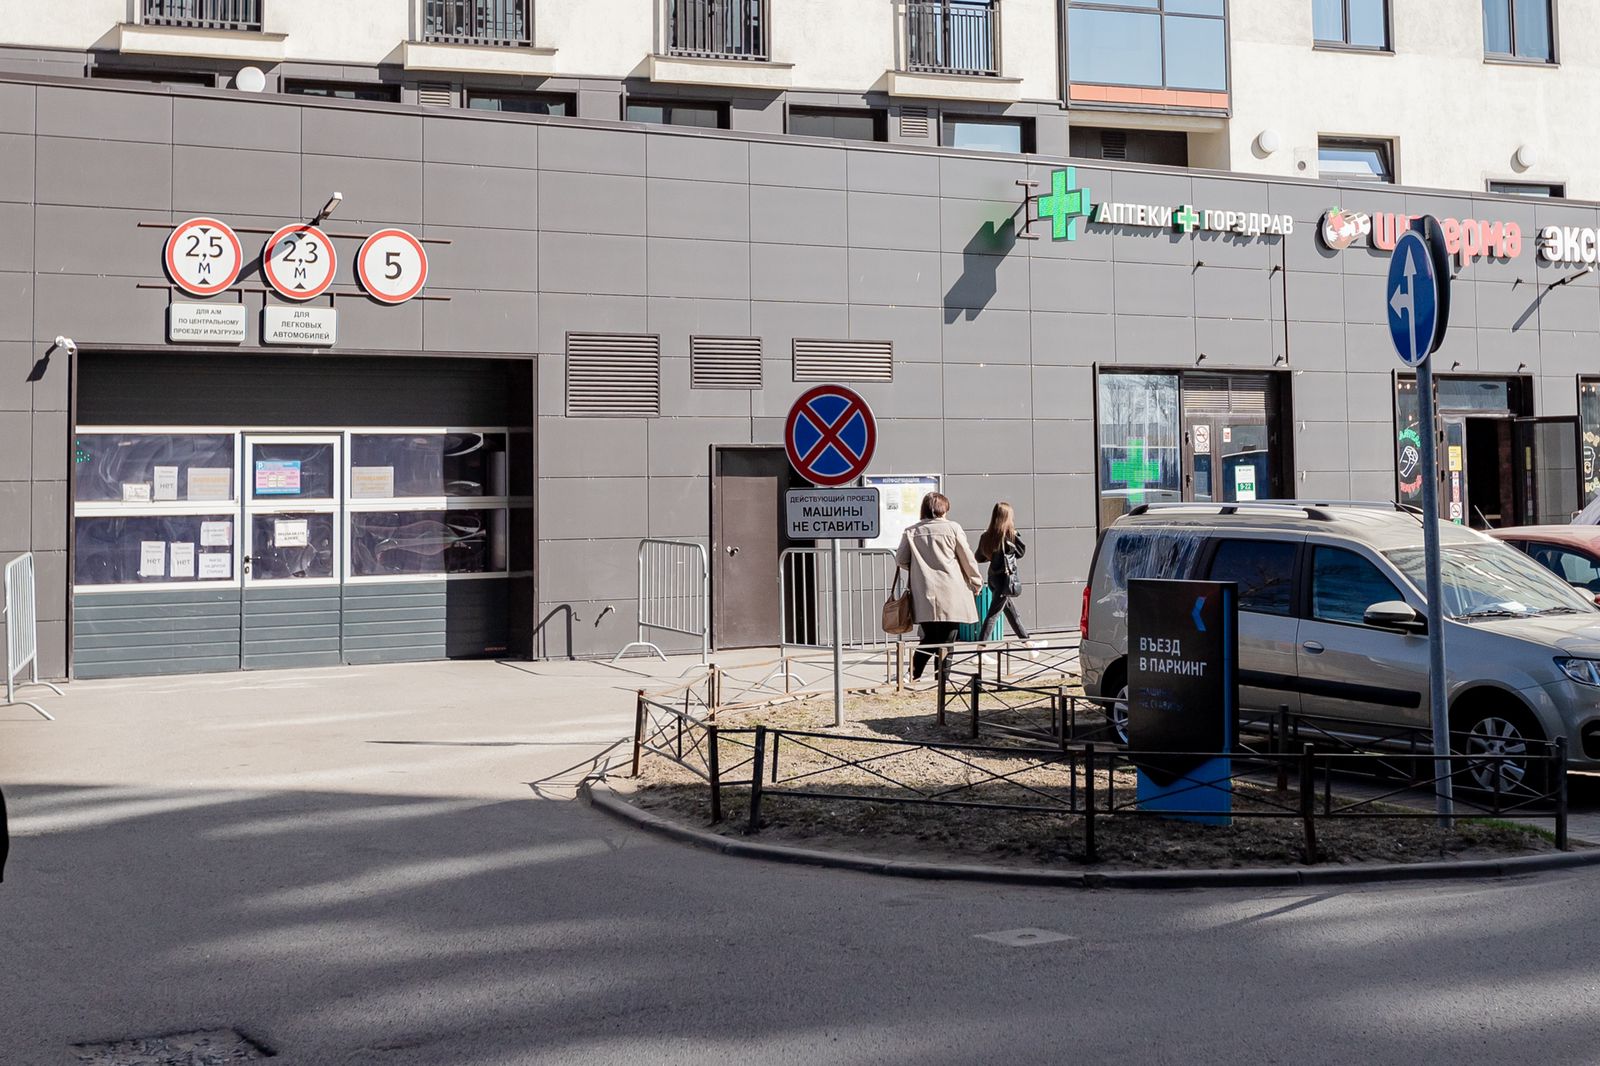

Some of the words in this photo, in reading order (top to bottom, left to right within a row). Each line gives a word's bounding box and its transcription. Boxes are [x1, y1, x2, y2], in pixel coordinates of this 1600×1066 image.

[1098, 202, 1172, 227] АПТЕКИ
[1204, 210, 1294, 237] ГОРЗДРАВ
[185, 235, 223, 261] 2,5
[282, 240, 318, 266] 2,3
[384, 252, 401, 280] 5
[196, 308, 210, 316] ДЛЯ
[293, 311, 310, 319] ДЛЯ
[188, 318, 239, 326] ЦЕНТРАЛЬНОМУ
[281, 321, 322, 329] ЛЕГКОВЫХ
[272, 331, 330, 340] АВТОМОБИЛЕЙ
[789, 495, 845, 504] ДЕЙСТВУЮЩИЙ
[847, 494, 875, 503] ПРОЕЗД
[802, 506, 863, 518] МАШИНЫ
[792, 522, 809, 532] НЕ
[812, 520, 874, 532] СТАВИТЬ!
[1140, 637, 1181, 657] ВЪЕЗД
[1139, 657, 1147, 671] В
[1150, 658, 1208, 677] ПАРКИНГ
